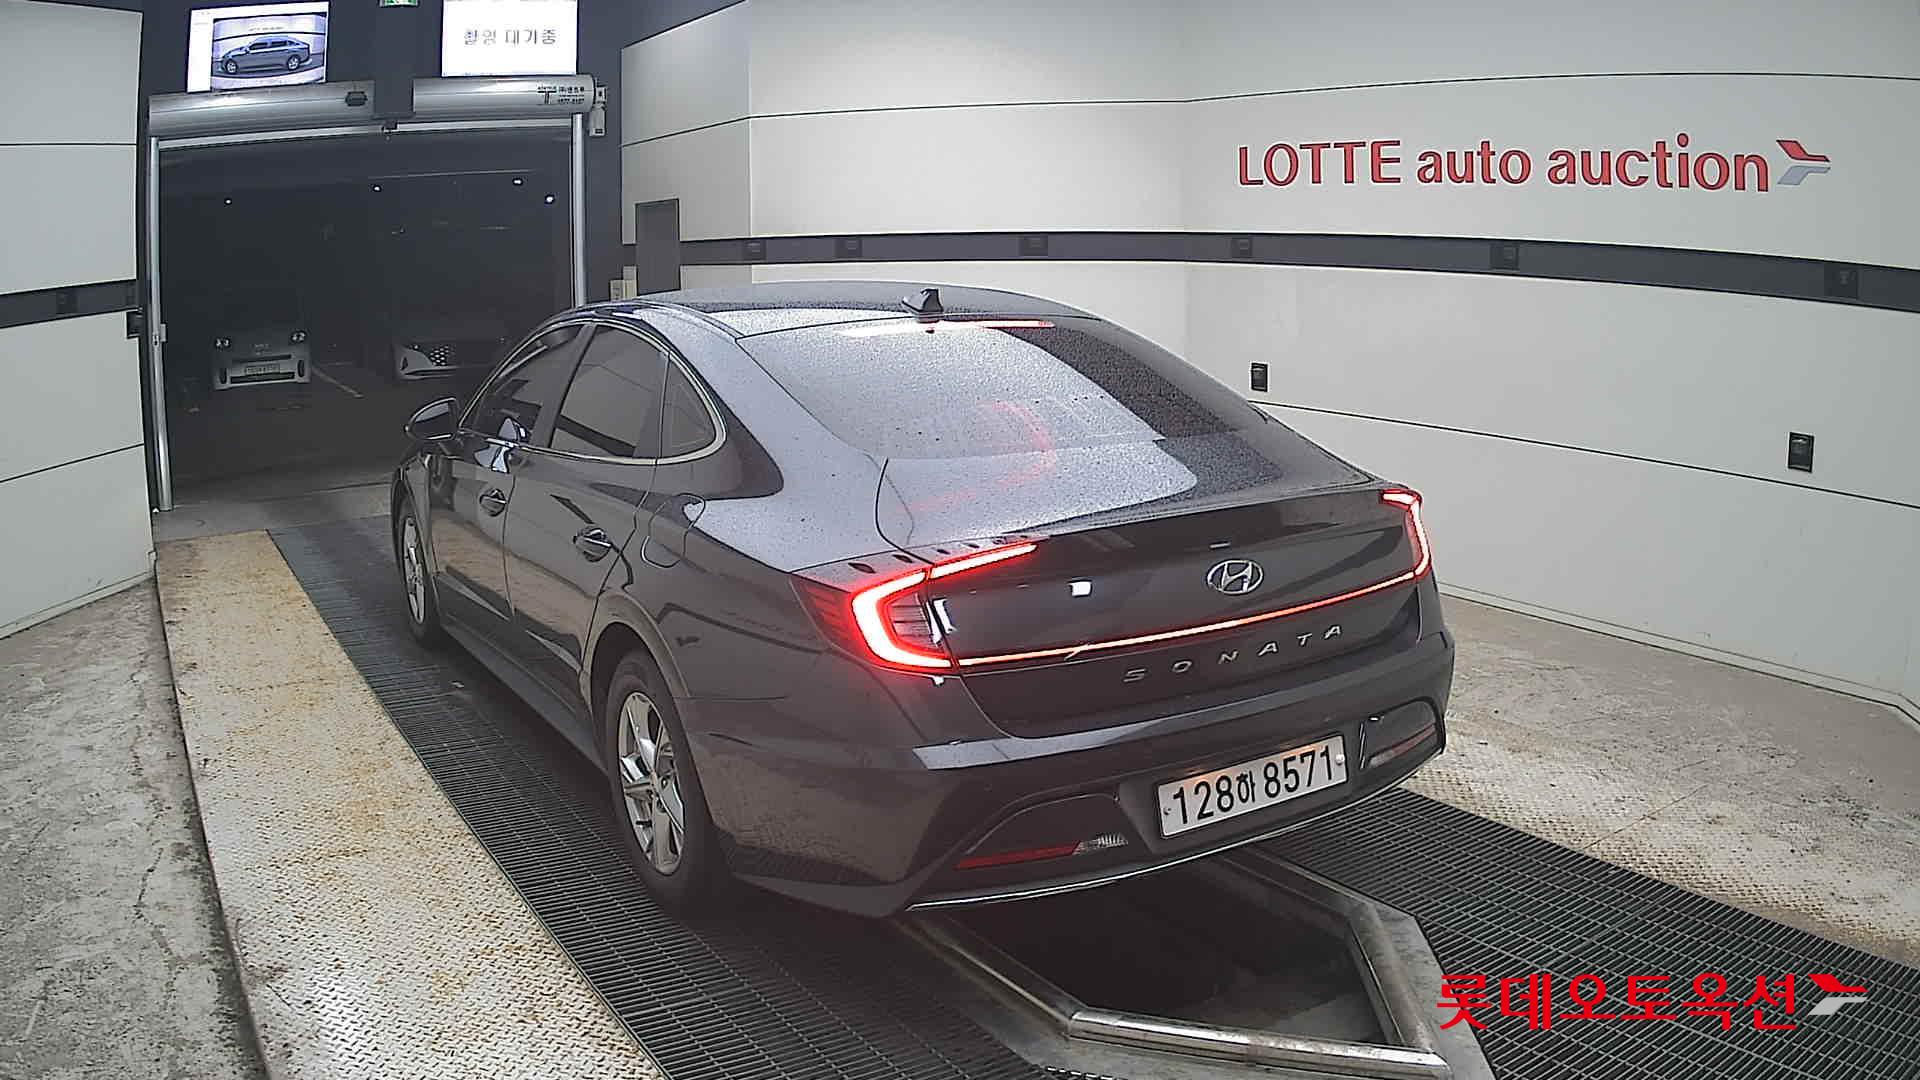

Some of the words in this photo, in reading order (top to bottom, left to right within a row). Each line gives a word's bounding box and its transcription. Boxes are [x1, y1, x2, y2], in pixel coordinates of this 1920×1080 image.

[505, 29, 557, 46] 대기중
[1238, 139, 1401, 187] LOTTE
[1415, 140, 1532, 184] auto
[1547, 132, 1769, 193] auction
[1122, 624, 1343, 683] SONATA
[1172, 770, 1257, 825] 128하
[1262, 745, 1333, 799] 8571
